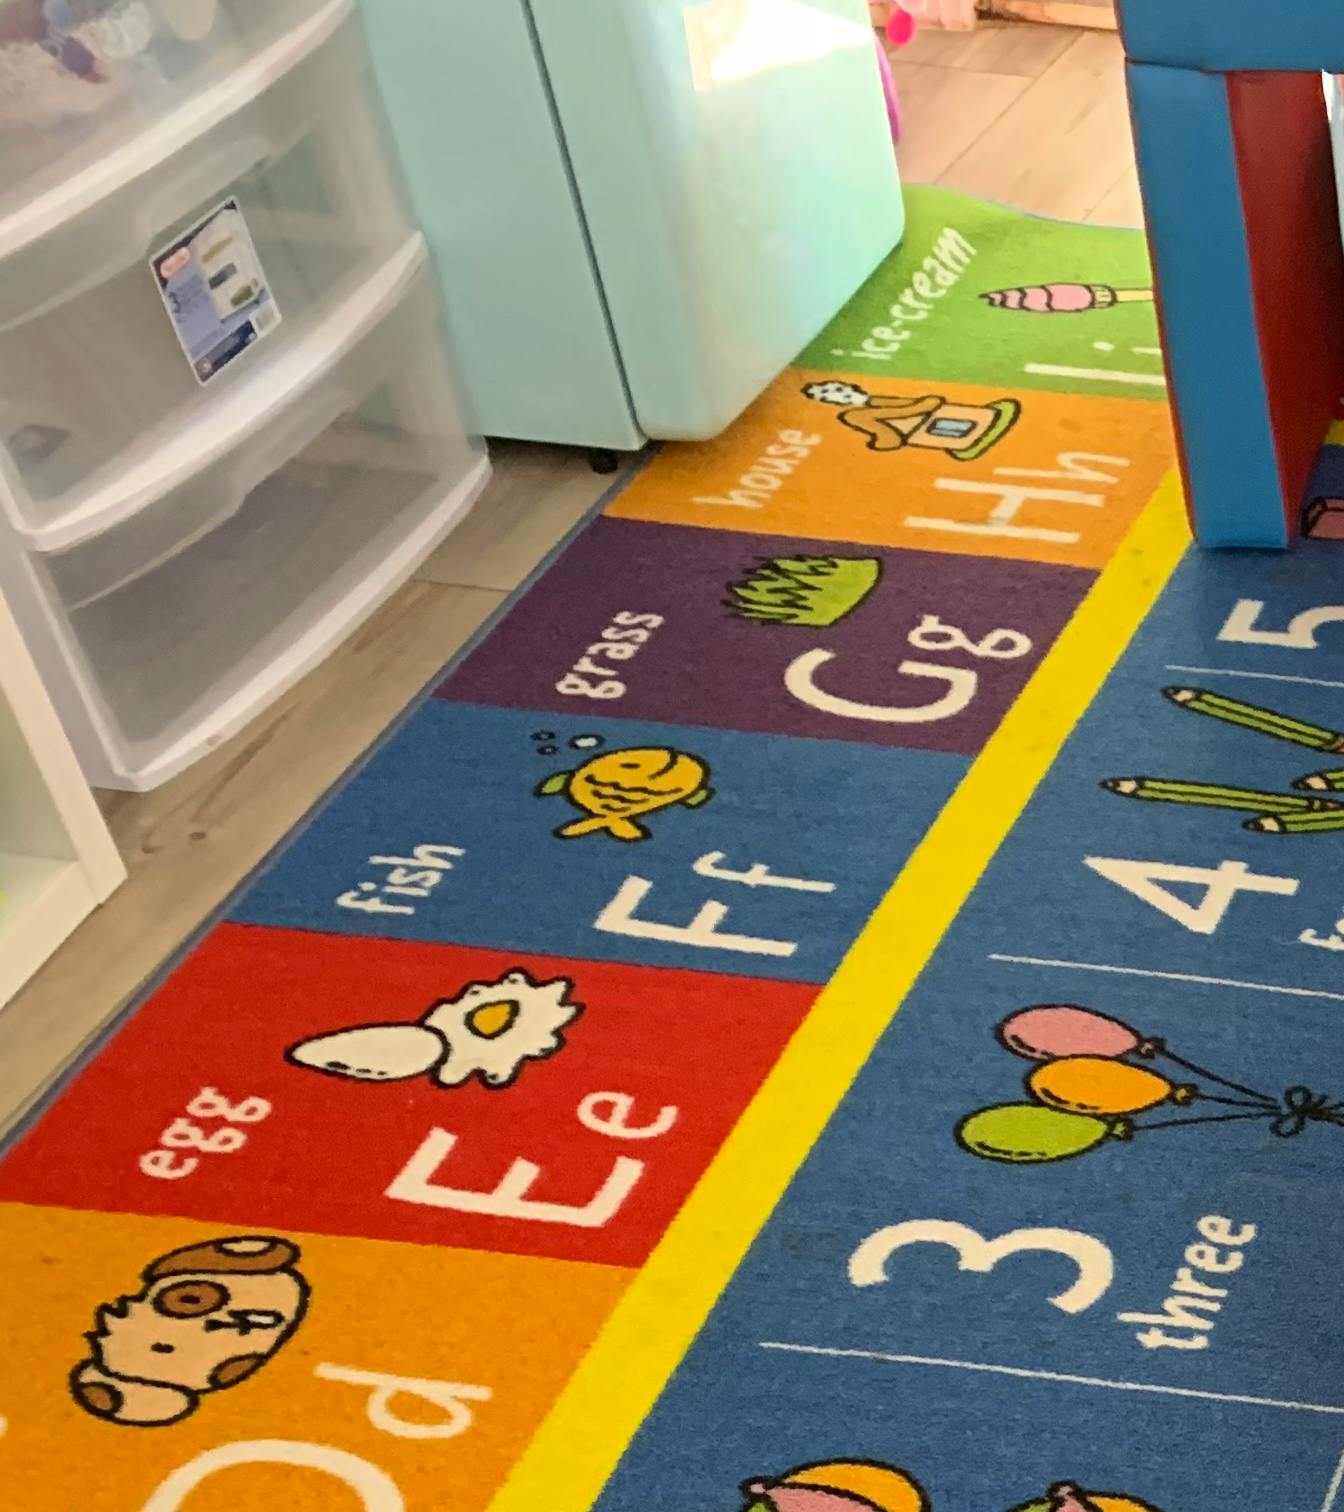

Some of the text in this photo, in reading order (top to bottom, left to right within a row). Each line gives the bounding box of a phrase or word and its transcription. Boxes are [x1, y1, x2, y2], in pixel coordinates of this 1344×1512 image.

[831, 227, 977, 360] ice-cream
[694, 427, 821, 511] house
[904, 449, 1130, 544] Hh
[556, 611, 664, 698] grass
[785, 615, 1032, 723] Gg
[337, 845, 465, 915] fish
[593, 851, 836, 957] Ff
[1083, 856, 1299, 935] 4
[140, 1087, 271, 1179] egg
[385, 1092, 677, 1227] Ee
[847, 1219, 1114, 1314] 3
[1116, 1215, 1257, 1350] three
